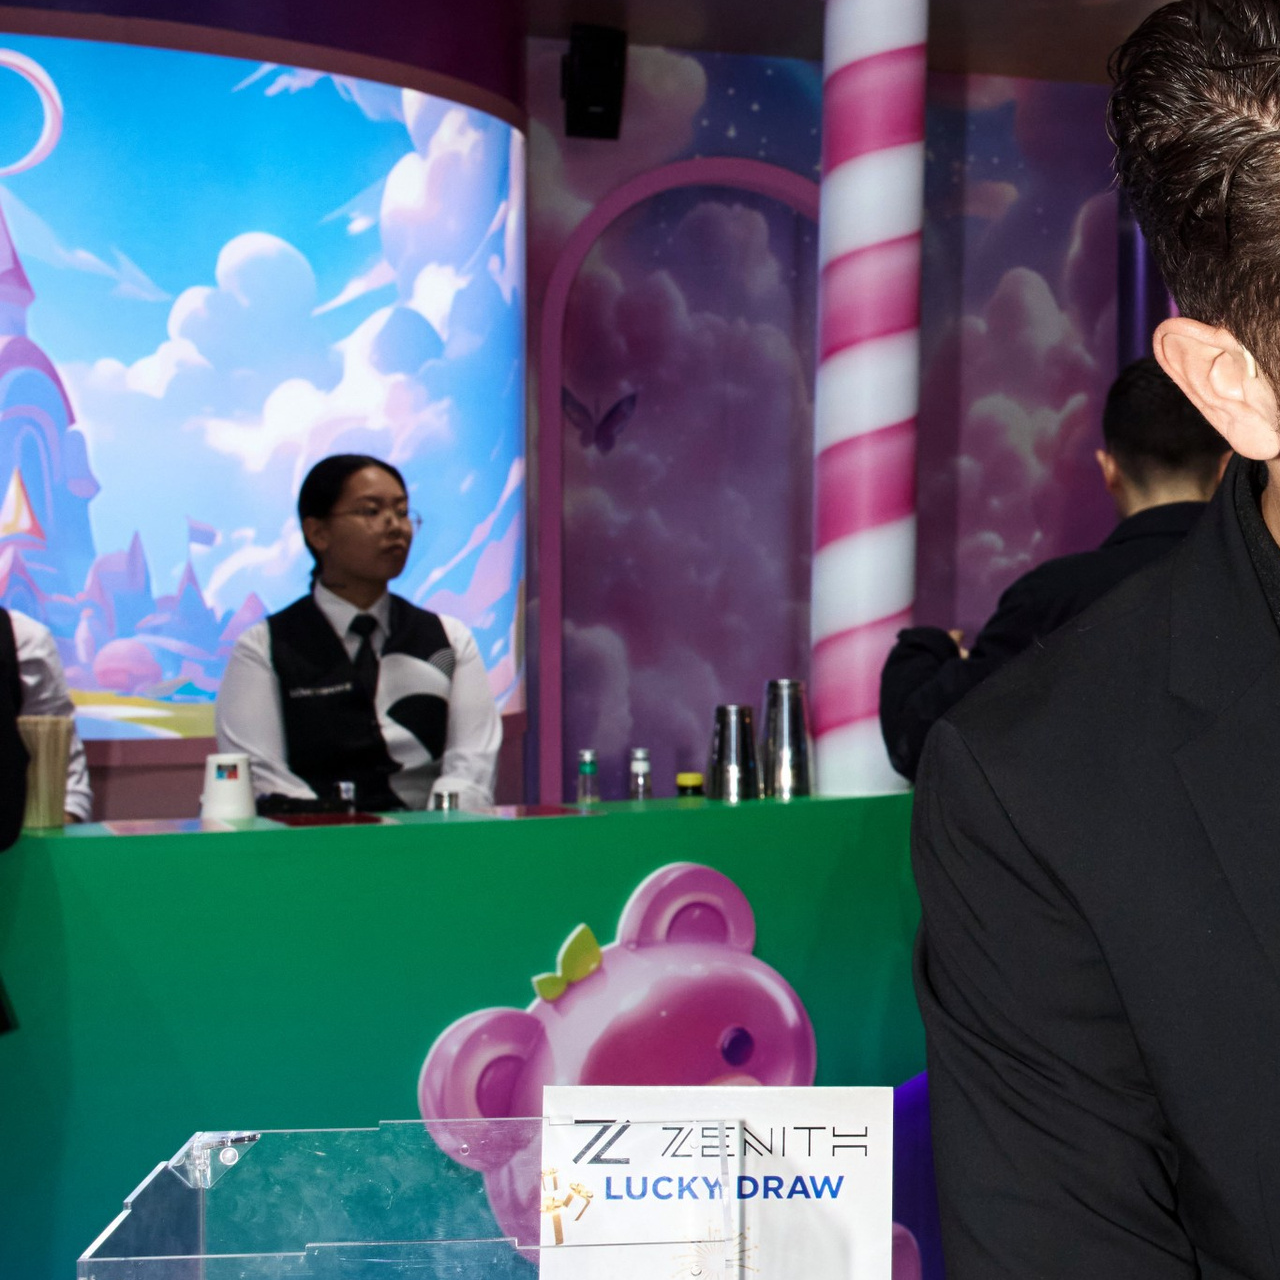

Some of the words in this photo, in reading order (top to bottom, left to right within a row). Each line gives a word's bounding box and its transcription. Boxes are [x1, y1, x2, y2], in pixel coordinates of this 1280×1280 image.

[661, 1126, 868, 1158] ZENITH
[605, 1175, 723, 1200] LUCKY
[736, 1175, 845, 1200] DRAW
